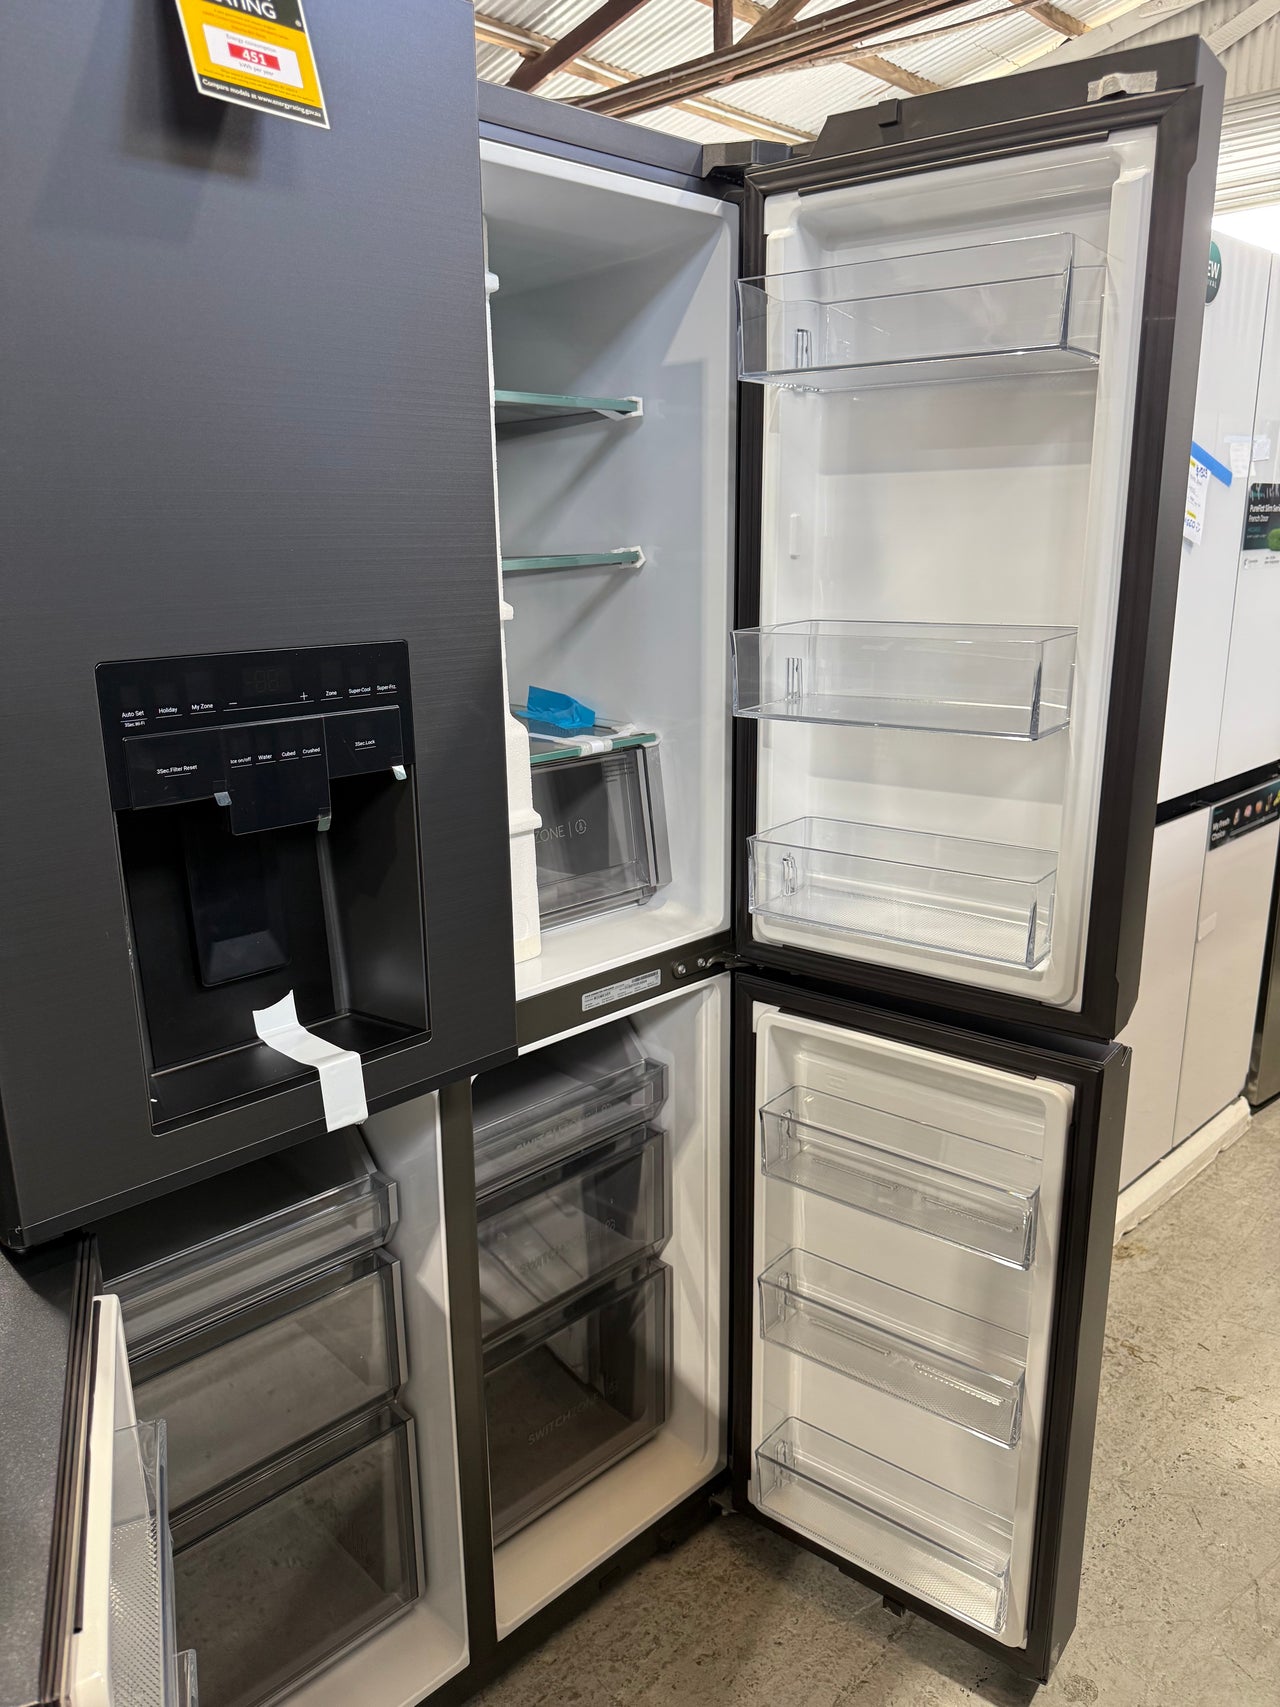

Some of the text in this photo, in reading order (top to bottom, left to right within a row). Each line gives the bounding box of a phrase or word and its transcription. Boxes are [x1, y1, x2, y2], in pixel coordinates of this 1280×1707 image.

[242, 49, 267, 66] 451
[202, 78, 229, 92] Compare
[230, 86, 250, 98] models
[258, 95, 321, 117] www.energyrating.gov.au
